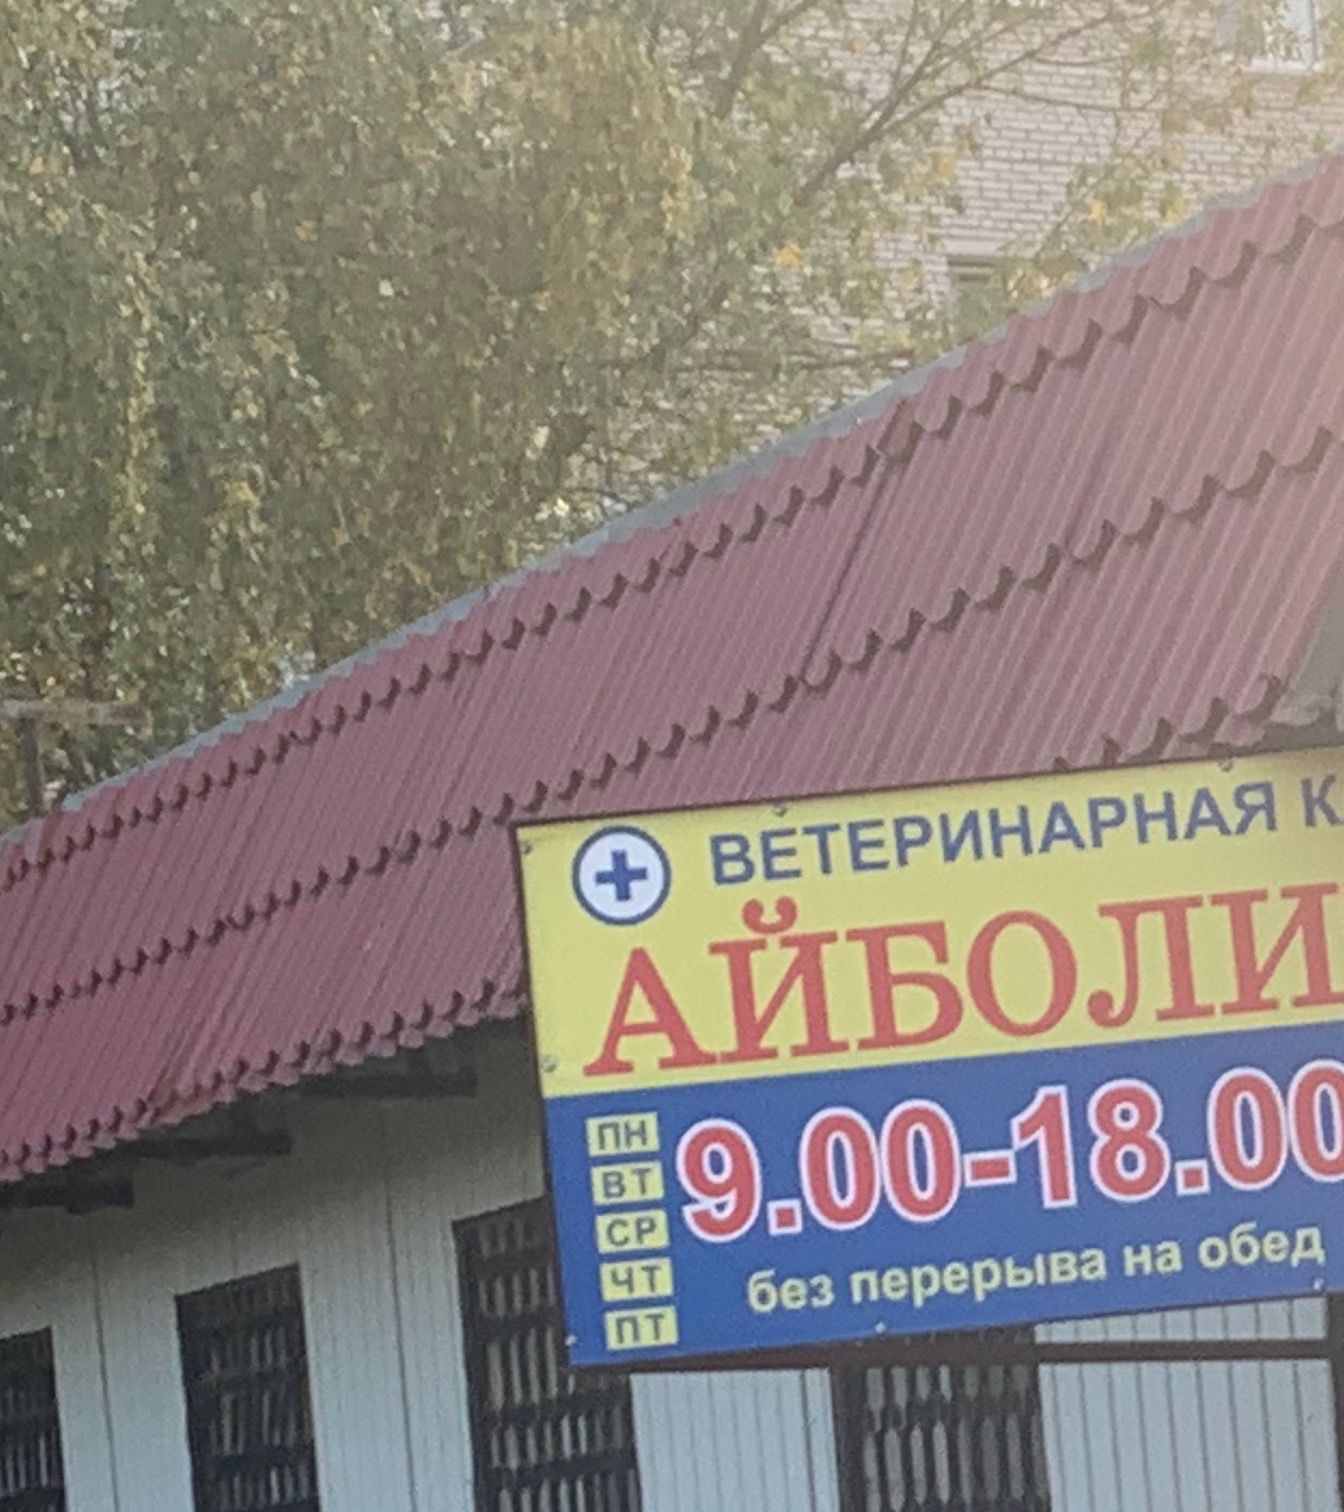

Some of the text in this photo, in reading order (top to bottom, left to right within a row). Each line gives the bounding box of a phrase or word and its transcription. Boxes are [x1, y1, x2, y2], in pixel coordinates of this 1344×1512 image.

[709, 781, 1277, 886] ВЕТЕРИНАРНАЯ
[597, 1122, 648, 1151] ПН
[602, 1167, 652, 1198] ВТ
[606, 1217, 657, 1247] СР
[610, 1265, 662, 1296] ЧТ
[747, 1221, 1325, 1314] без перерыва на обед
[615, 1315, 665, 1345] ПТ
